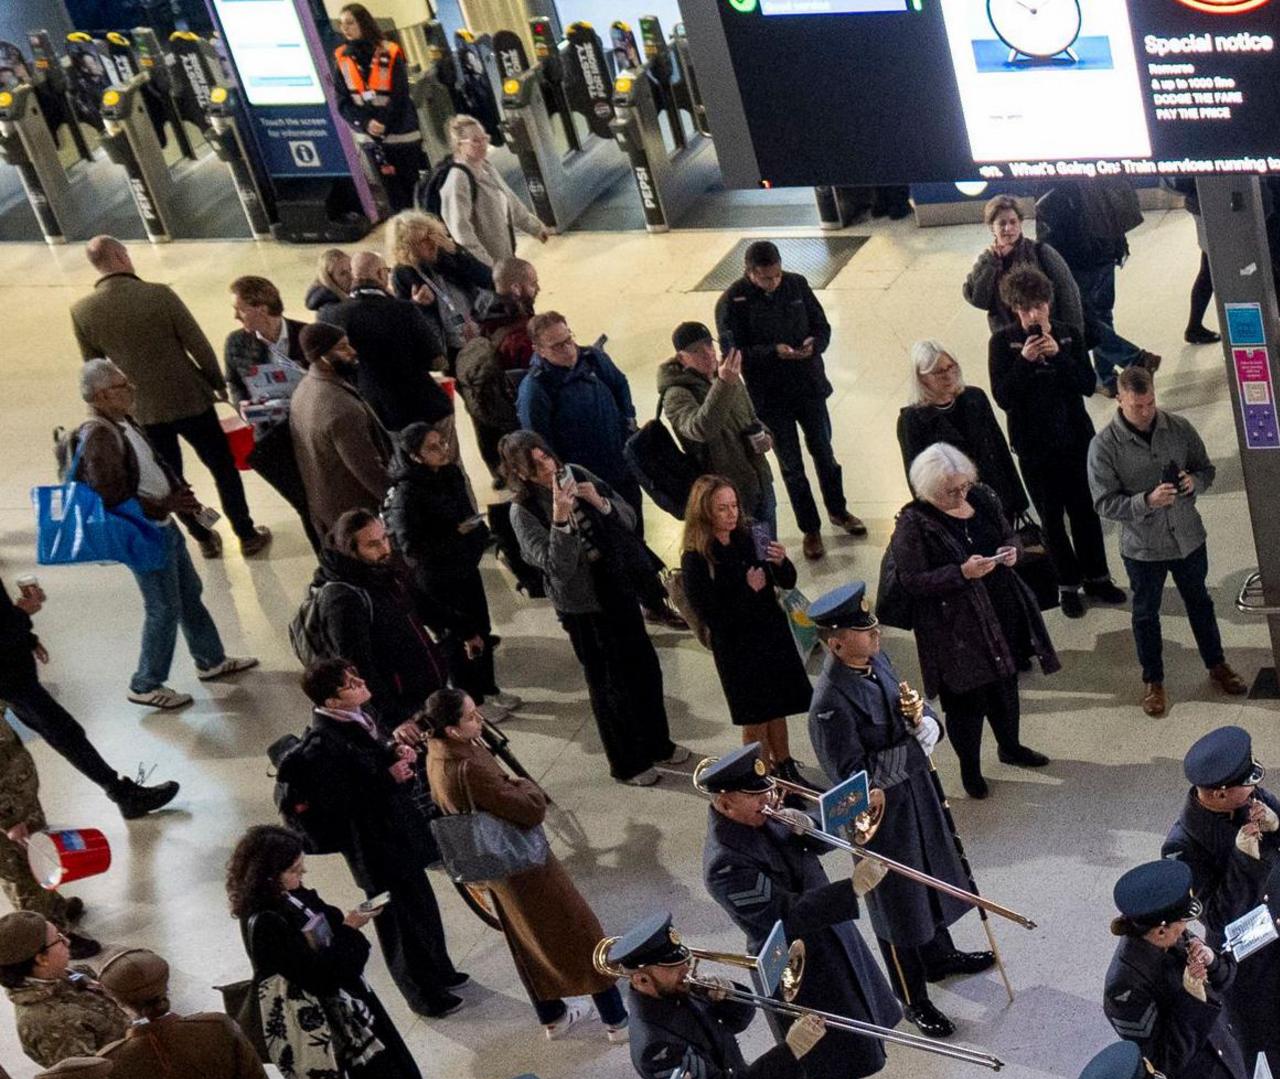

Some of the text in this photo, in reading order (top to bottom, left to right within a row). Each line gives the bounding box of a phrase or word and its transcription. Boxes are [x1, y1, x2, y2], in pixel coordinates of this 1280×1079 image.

[1144, 32, 1273, 56] Special notice
[260, 117, 327, 127] Touch the screen
[267, 129, 329, 138] for information
[1056, 161, 1096, 177] Going
[1121, 159, 1156, 173] Train
[1157, 158, 1214, 172] services
[1214, 157, 1267, 172] running
[635, 166, 656, 209] PEPSI
